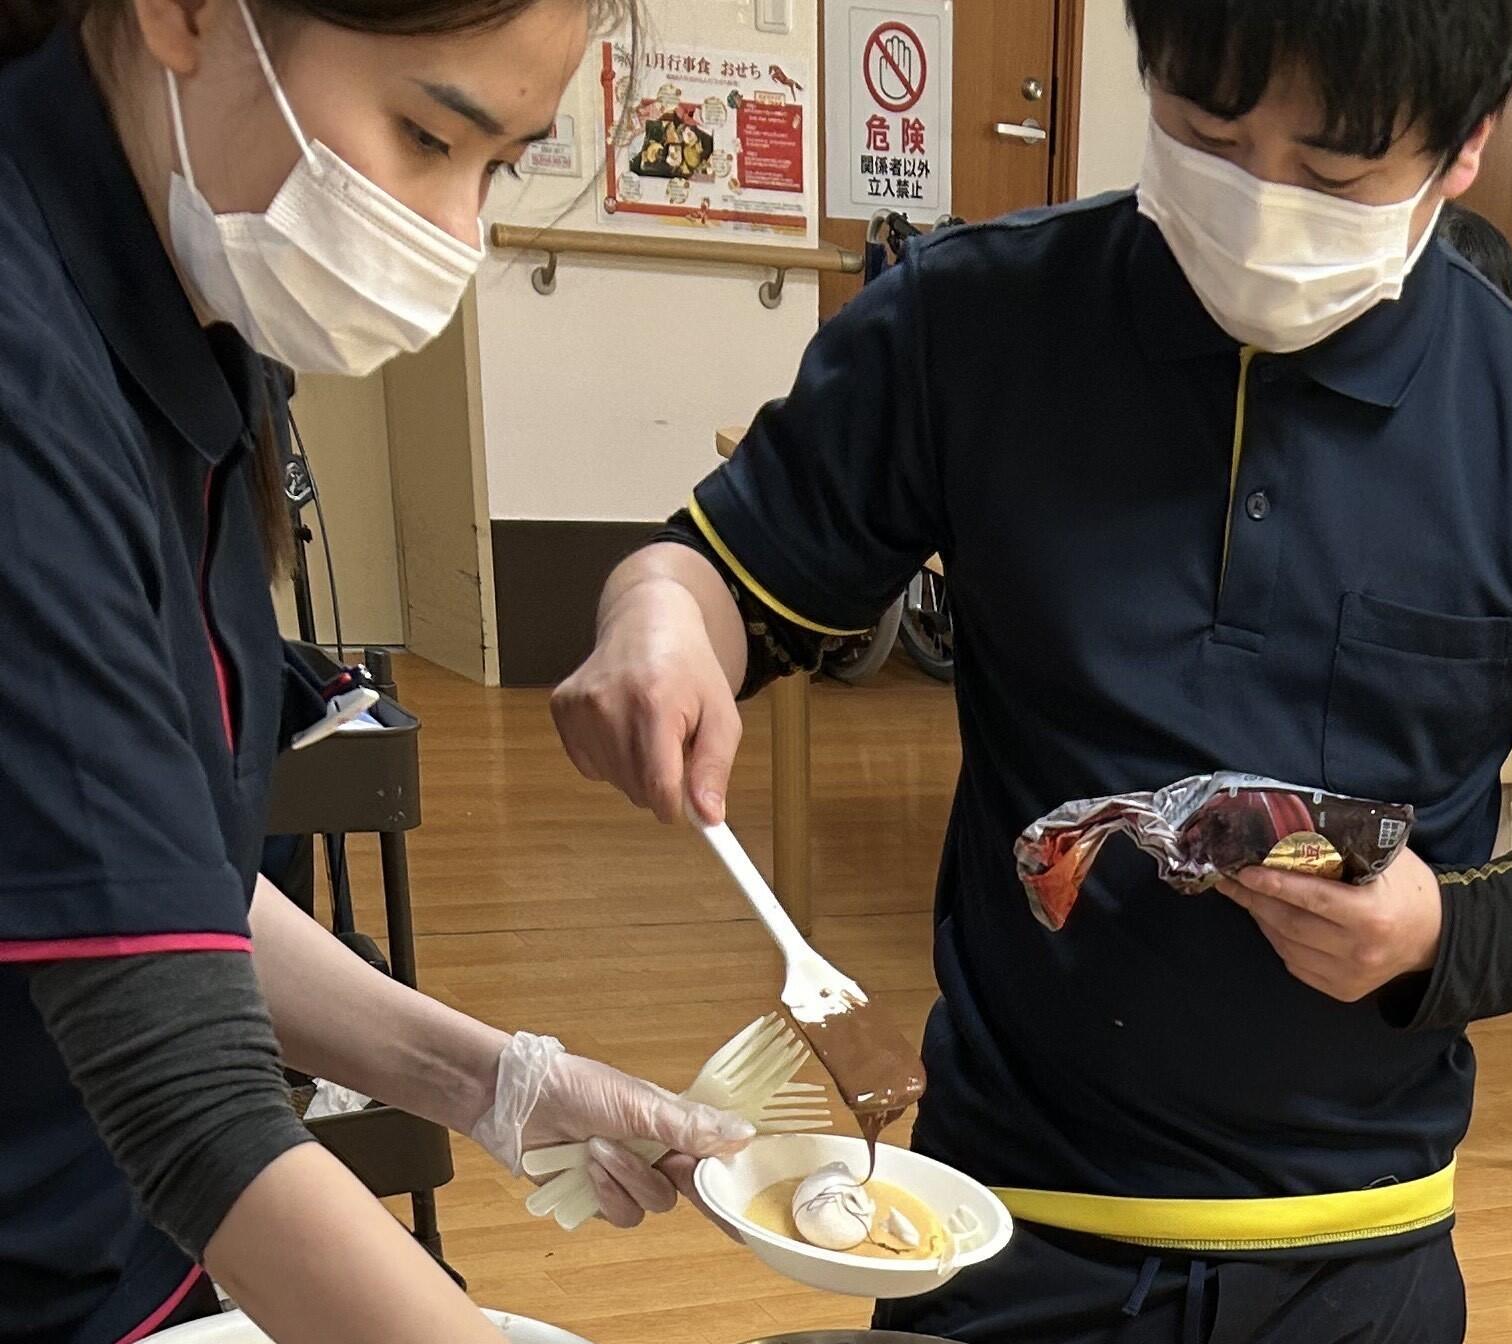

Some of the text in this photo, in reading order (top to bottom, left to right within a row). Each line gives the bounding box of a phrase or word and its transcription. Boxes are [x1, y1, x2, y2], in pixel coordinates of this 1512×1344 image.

[645, 53, 761, 80] 1月行事食 おせち
[865, 113, 926, 155] 危険
[860, 154, 931, 179] 関係者以外
[867, 176, 924, 200] 立入禁止
